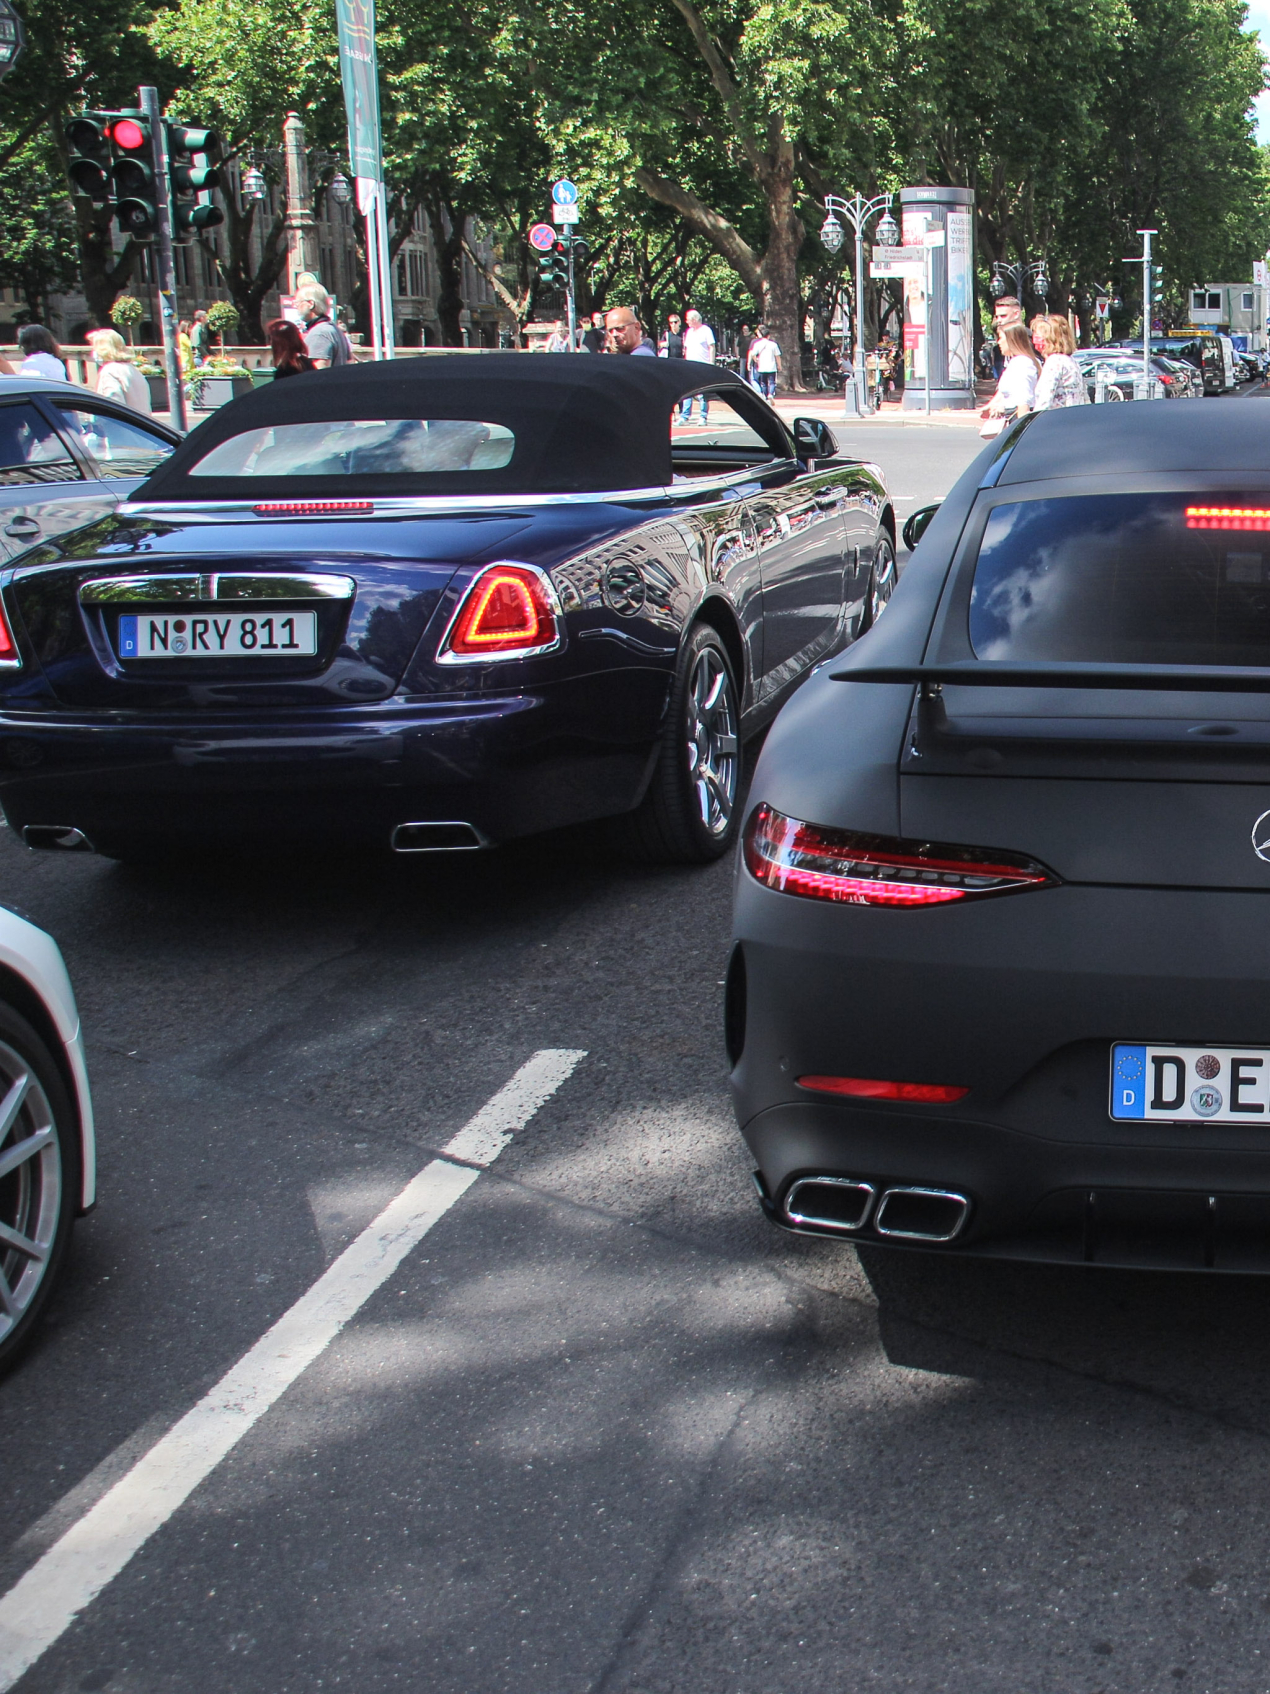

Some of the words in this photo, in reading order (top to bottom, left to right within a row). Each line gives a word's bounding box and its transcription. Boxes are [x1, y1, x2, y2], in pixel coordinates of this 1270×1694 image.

[125, 640, 133, 650] D
[150, 619, 169, 651] N
[191, 618, 232, 650] RY
[240, 617, 300, 650] 811
[1150, 1055, 1187, 1111] D
[1122, 1089, 1135, 1106] D
